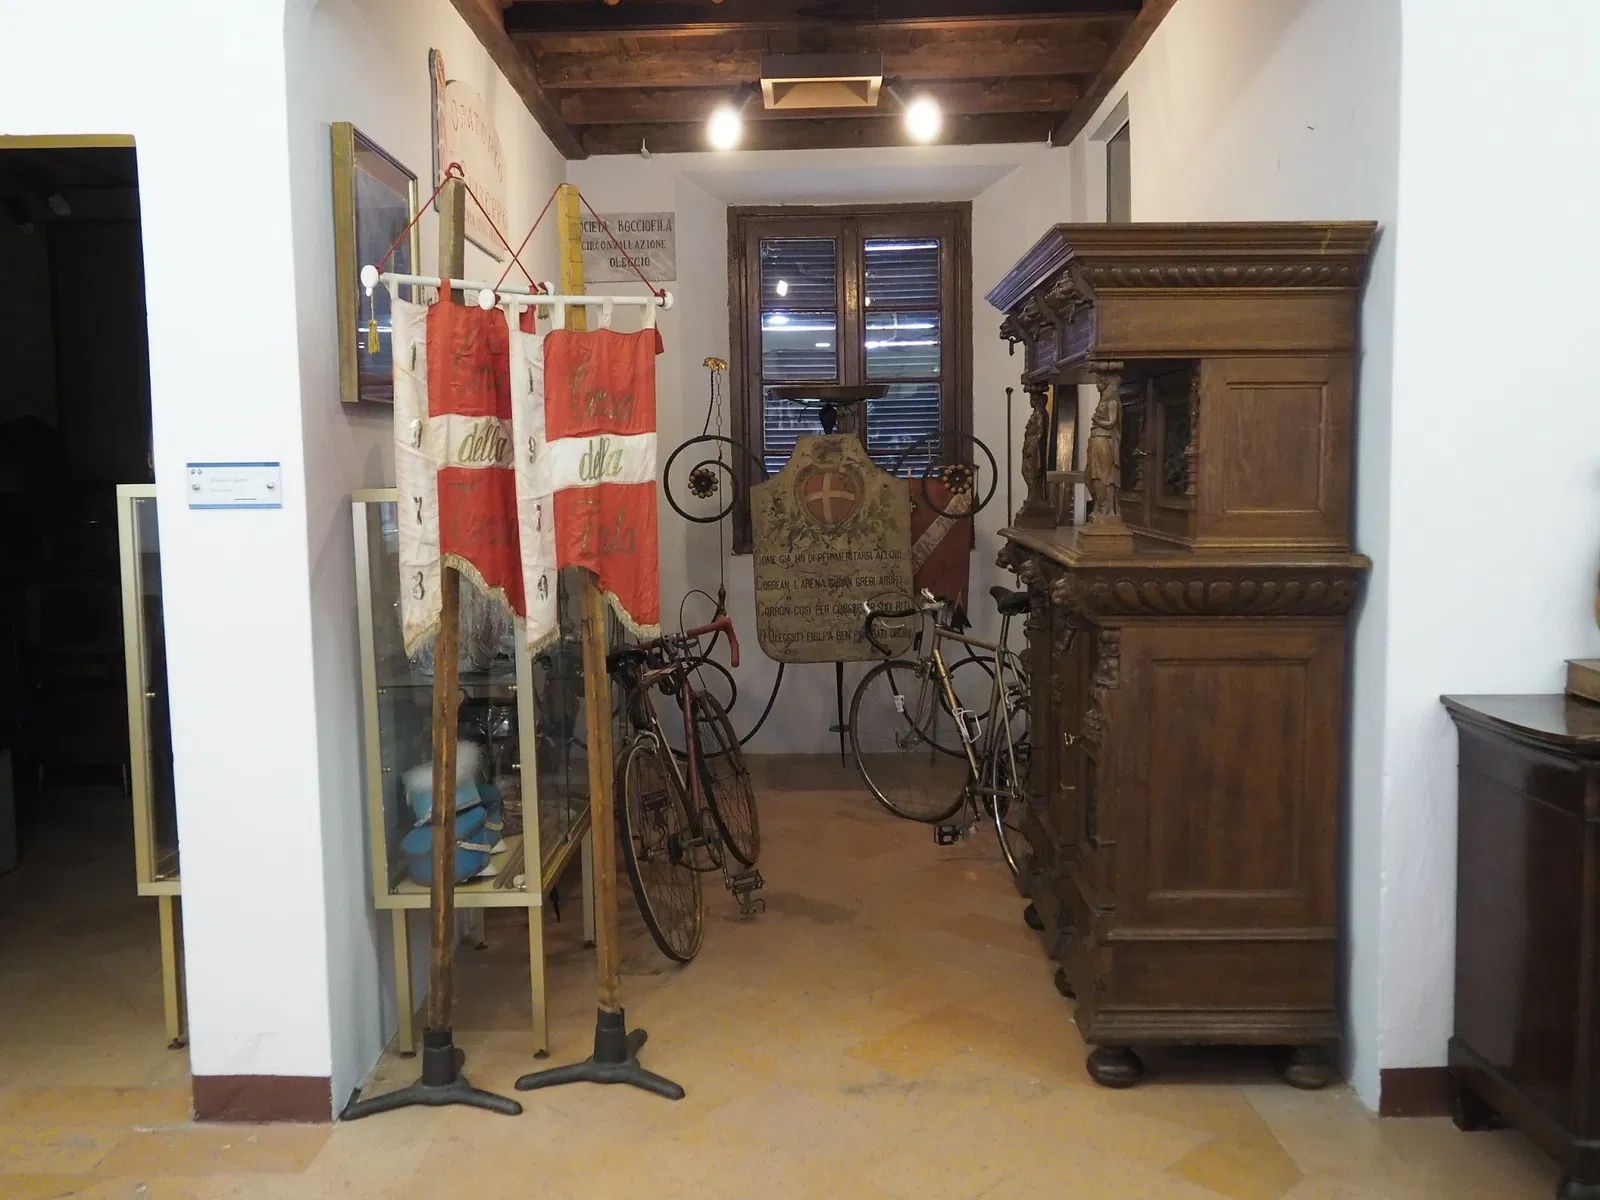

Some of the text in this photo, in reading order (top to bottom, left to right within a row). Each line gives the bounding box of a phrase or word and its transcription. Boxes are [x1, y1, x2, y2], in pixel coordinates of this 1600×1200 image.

[618, 219, 673, 233] BOCCIOFILA
[457, 422, 509, 463] della
[815, 603, 830, 616] PER
